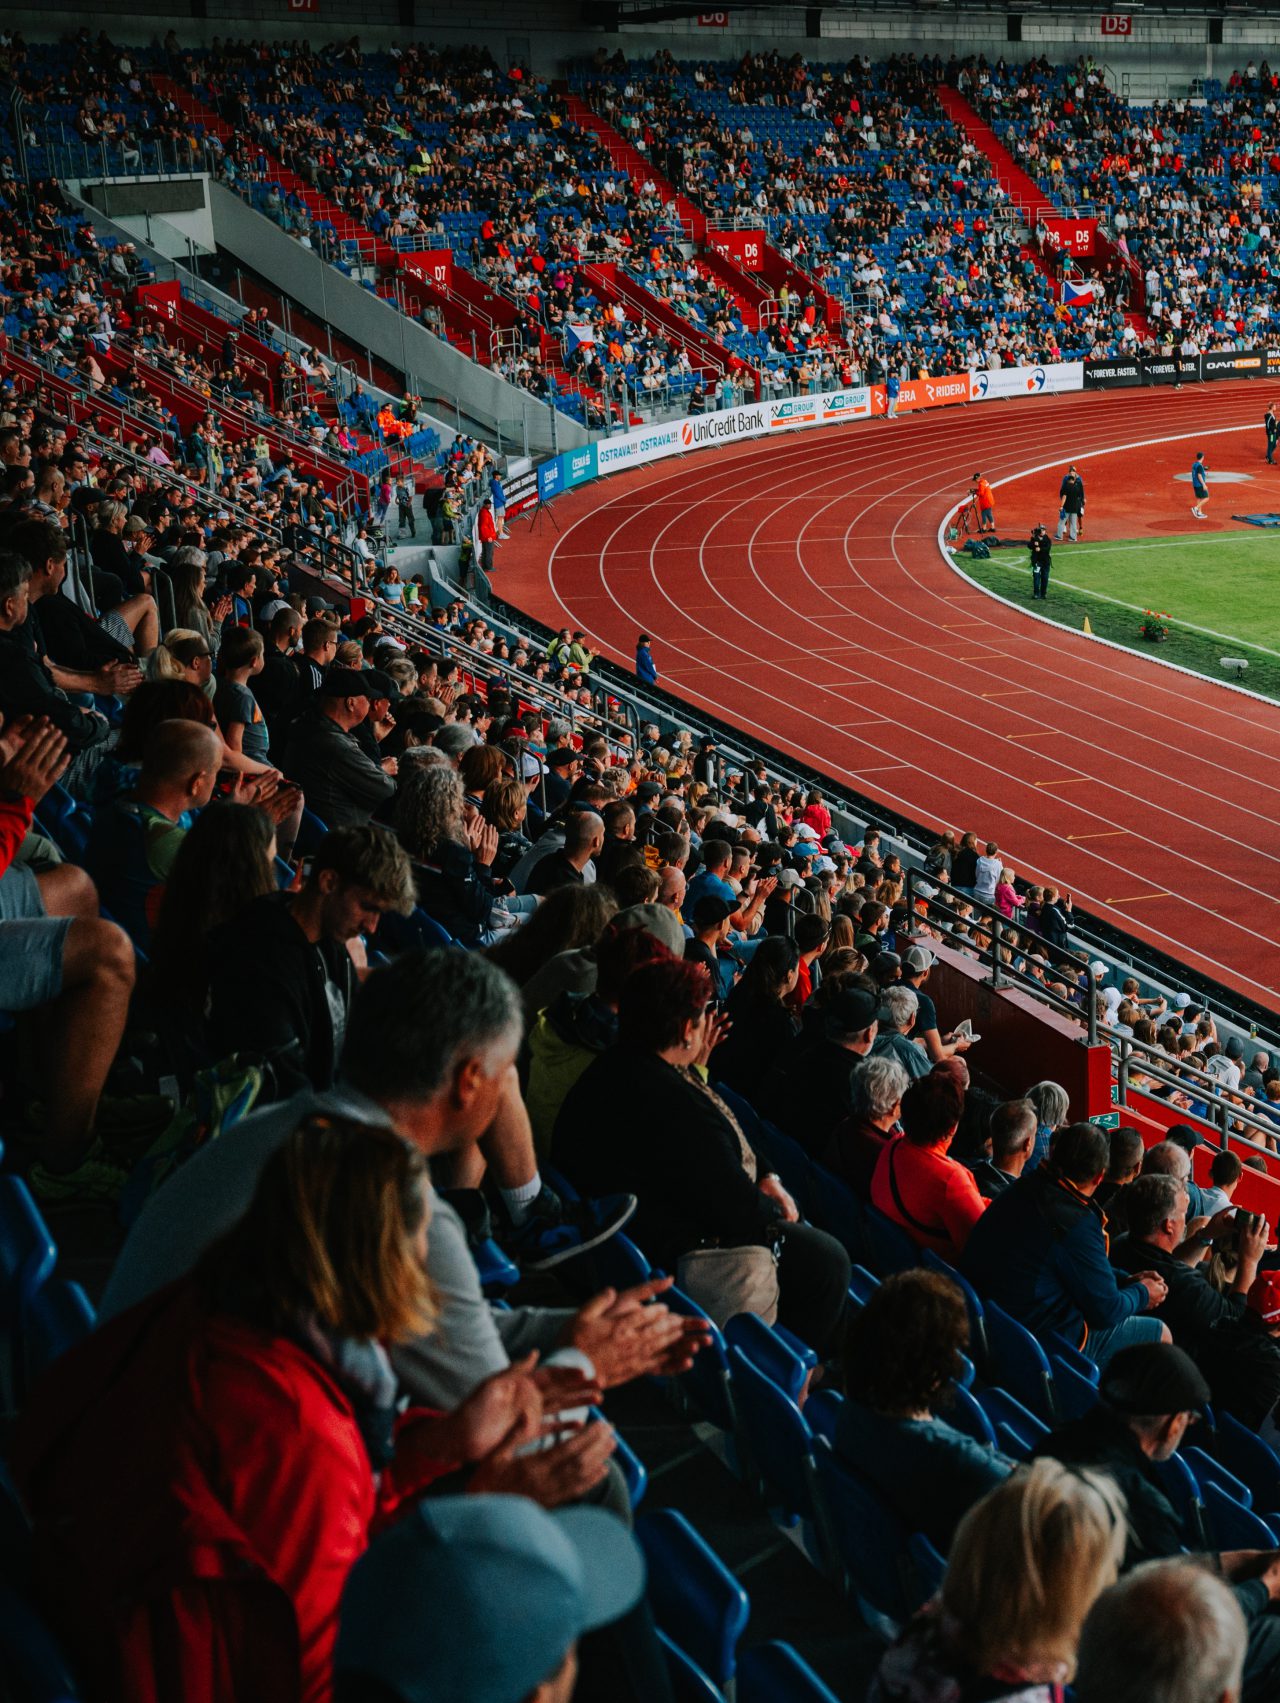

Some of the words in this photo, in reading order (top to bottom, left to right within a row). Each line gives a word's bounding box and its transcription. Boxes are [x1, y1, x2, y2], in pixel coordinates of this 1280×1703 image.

[1105, 16, 1128, 32] D5
[1076, 230, 1089, 243] D5
[745, 243, 758, 257] D6
[434, 266, 446, 281] D7
[936, 383, 966, 398] RIDERA
[794, 402, 813, 412] GROUP
[845, 395, 864, 404] GROUP
[694, 414, 736, 442] UniCredit
[738, 410, 764, 432] Bank
[640, 432, 677, 452] OSTRAVA!!!
[600, 442, 637, 462] OSTRAVA!!!
